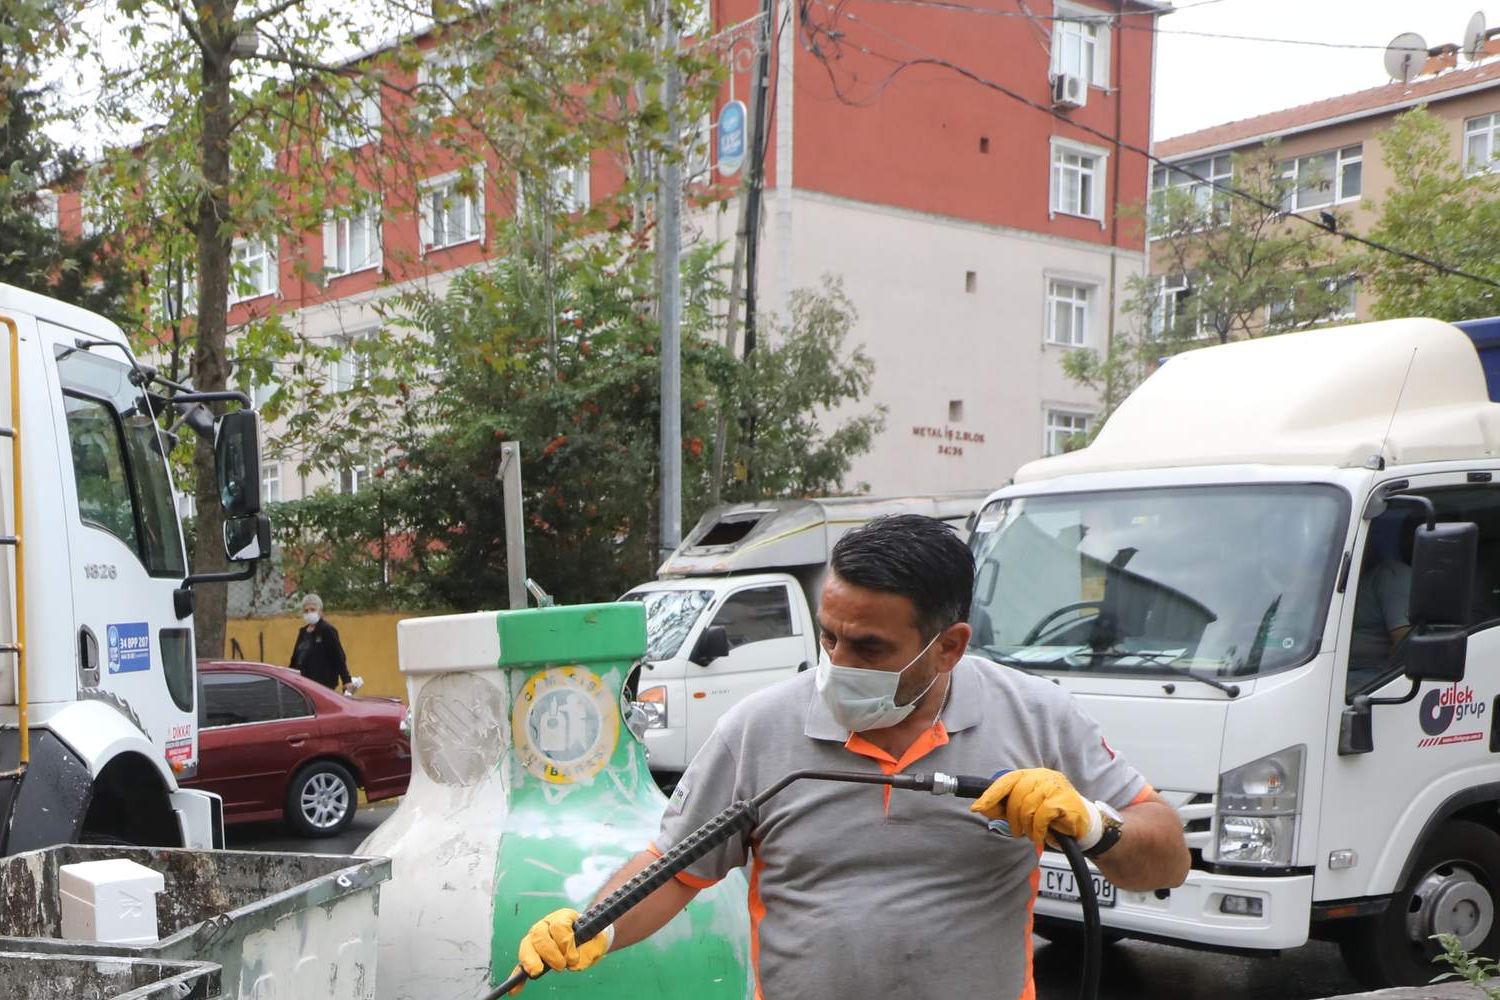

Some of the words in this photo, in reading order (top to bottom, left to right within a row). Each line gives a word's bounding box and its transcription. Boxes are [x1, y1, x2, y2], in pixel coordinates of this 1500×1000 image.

[1441, 681, 1473, 706] dilek
[1456, 702, 1485, 721] grup
[1047, 871, 1074, 893] CYJ
